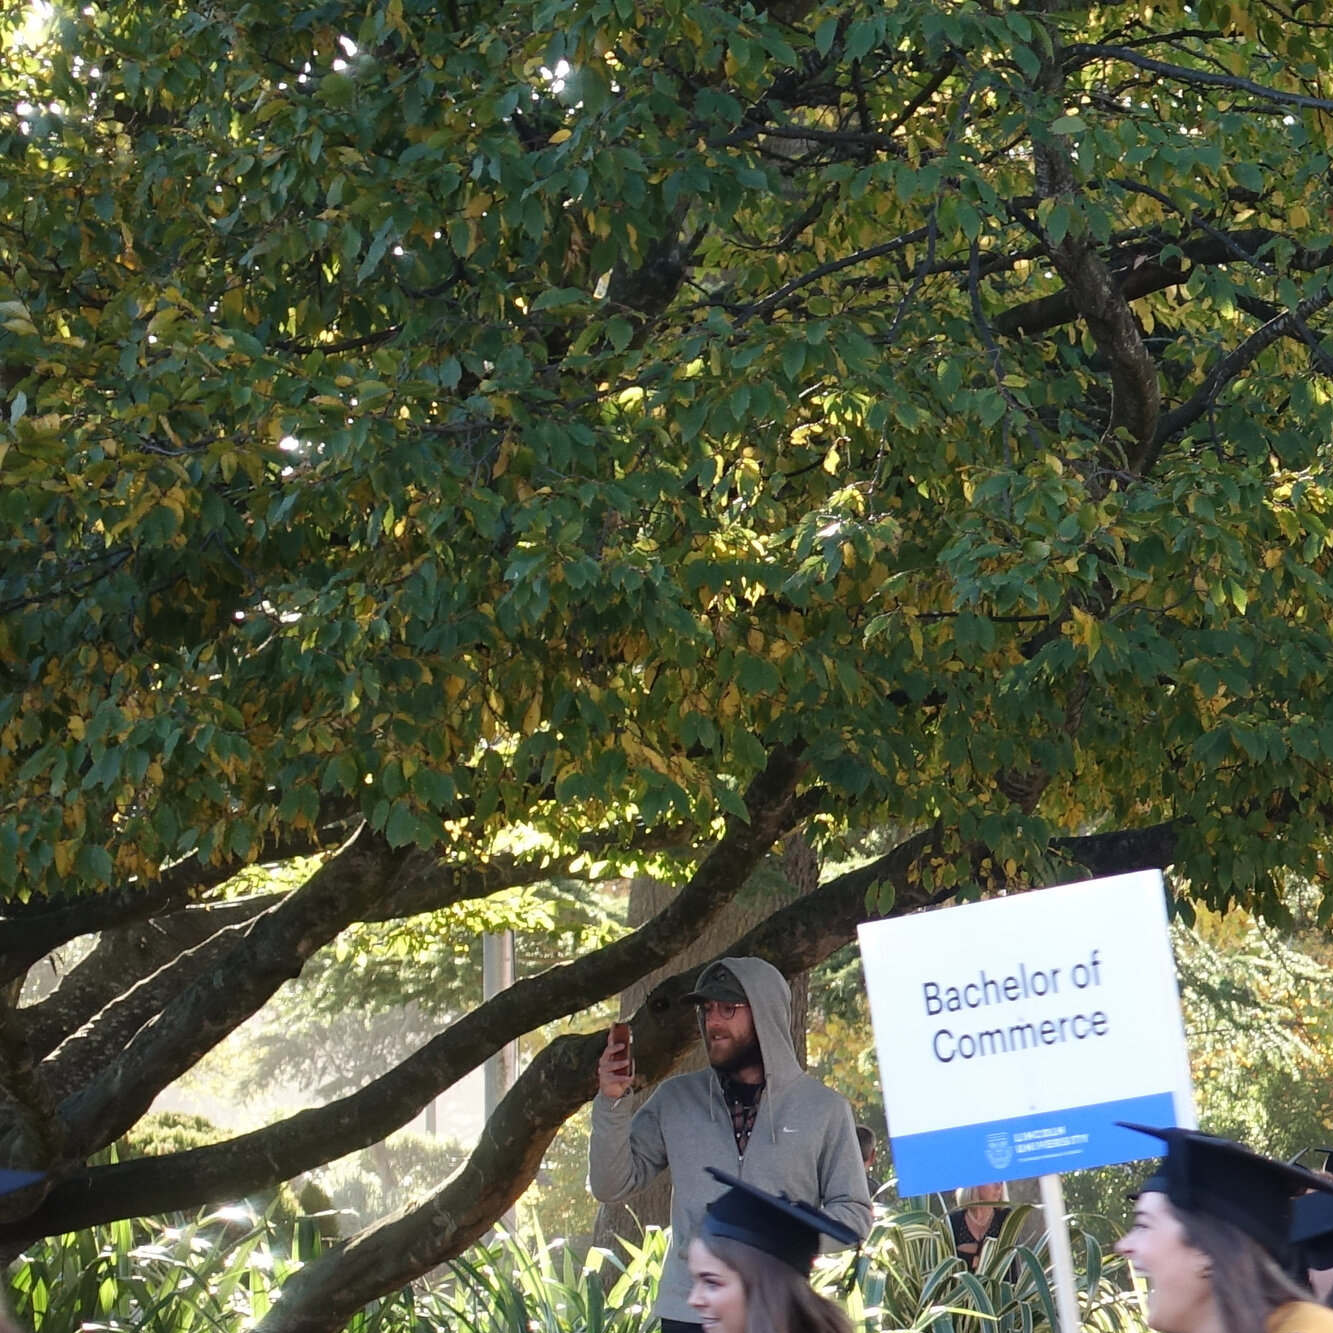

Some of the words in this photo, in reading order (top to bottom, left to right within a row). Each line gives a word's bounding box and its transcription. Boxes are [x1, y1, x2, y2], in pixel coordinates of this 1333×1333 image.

[922, 962, 1062, 1016] Bachelor
[1071, 950, 1104, 990] of
[933, 1010, 1109, 1063] Commerce
